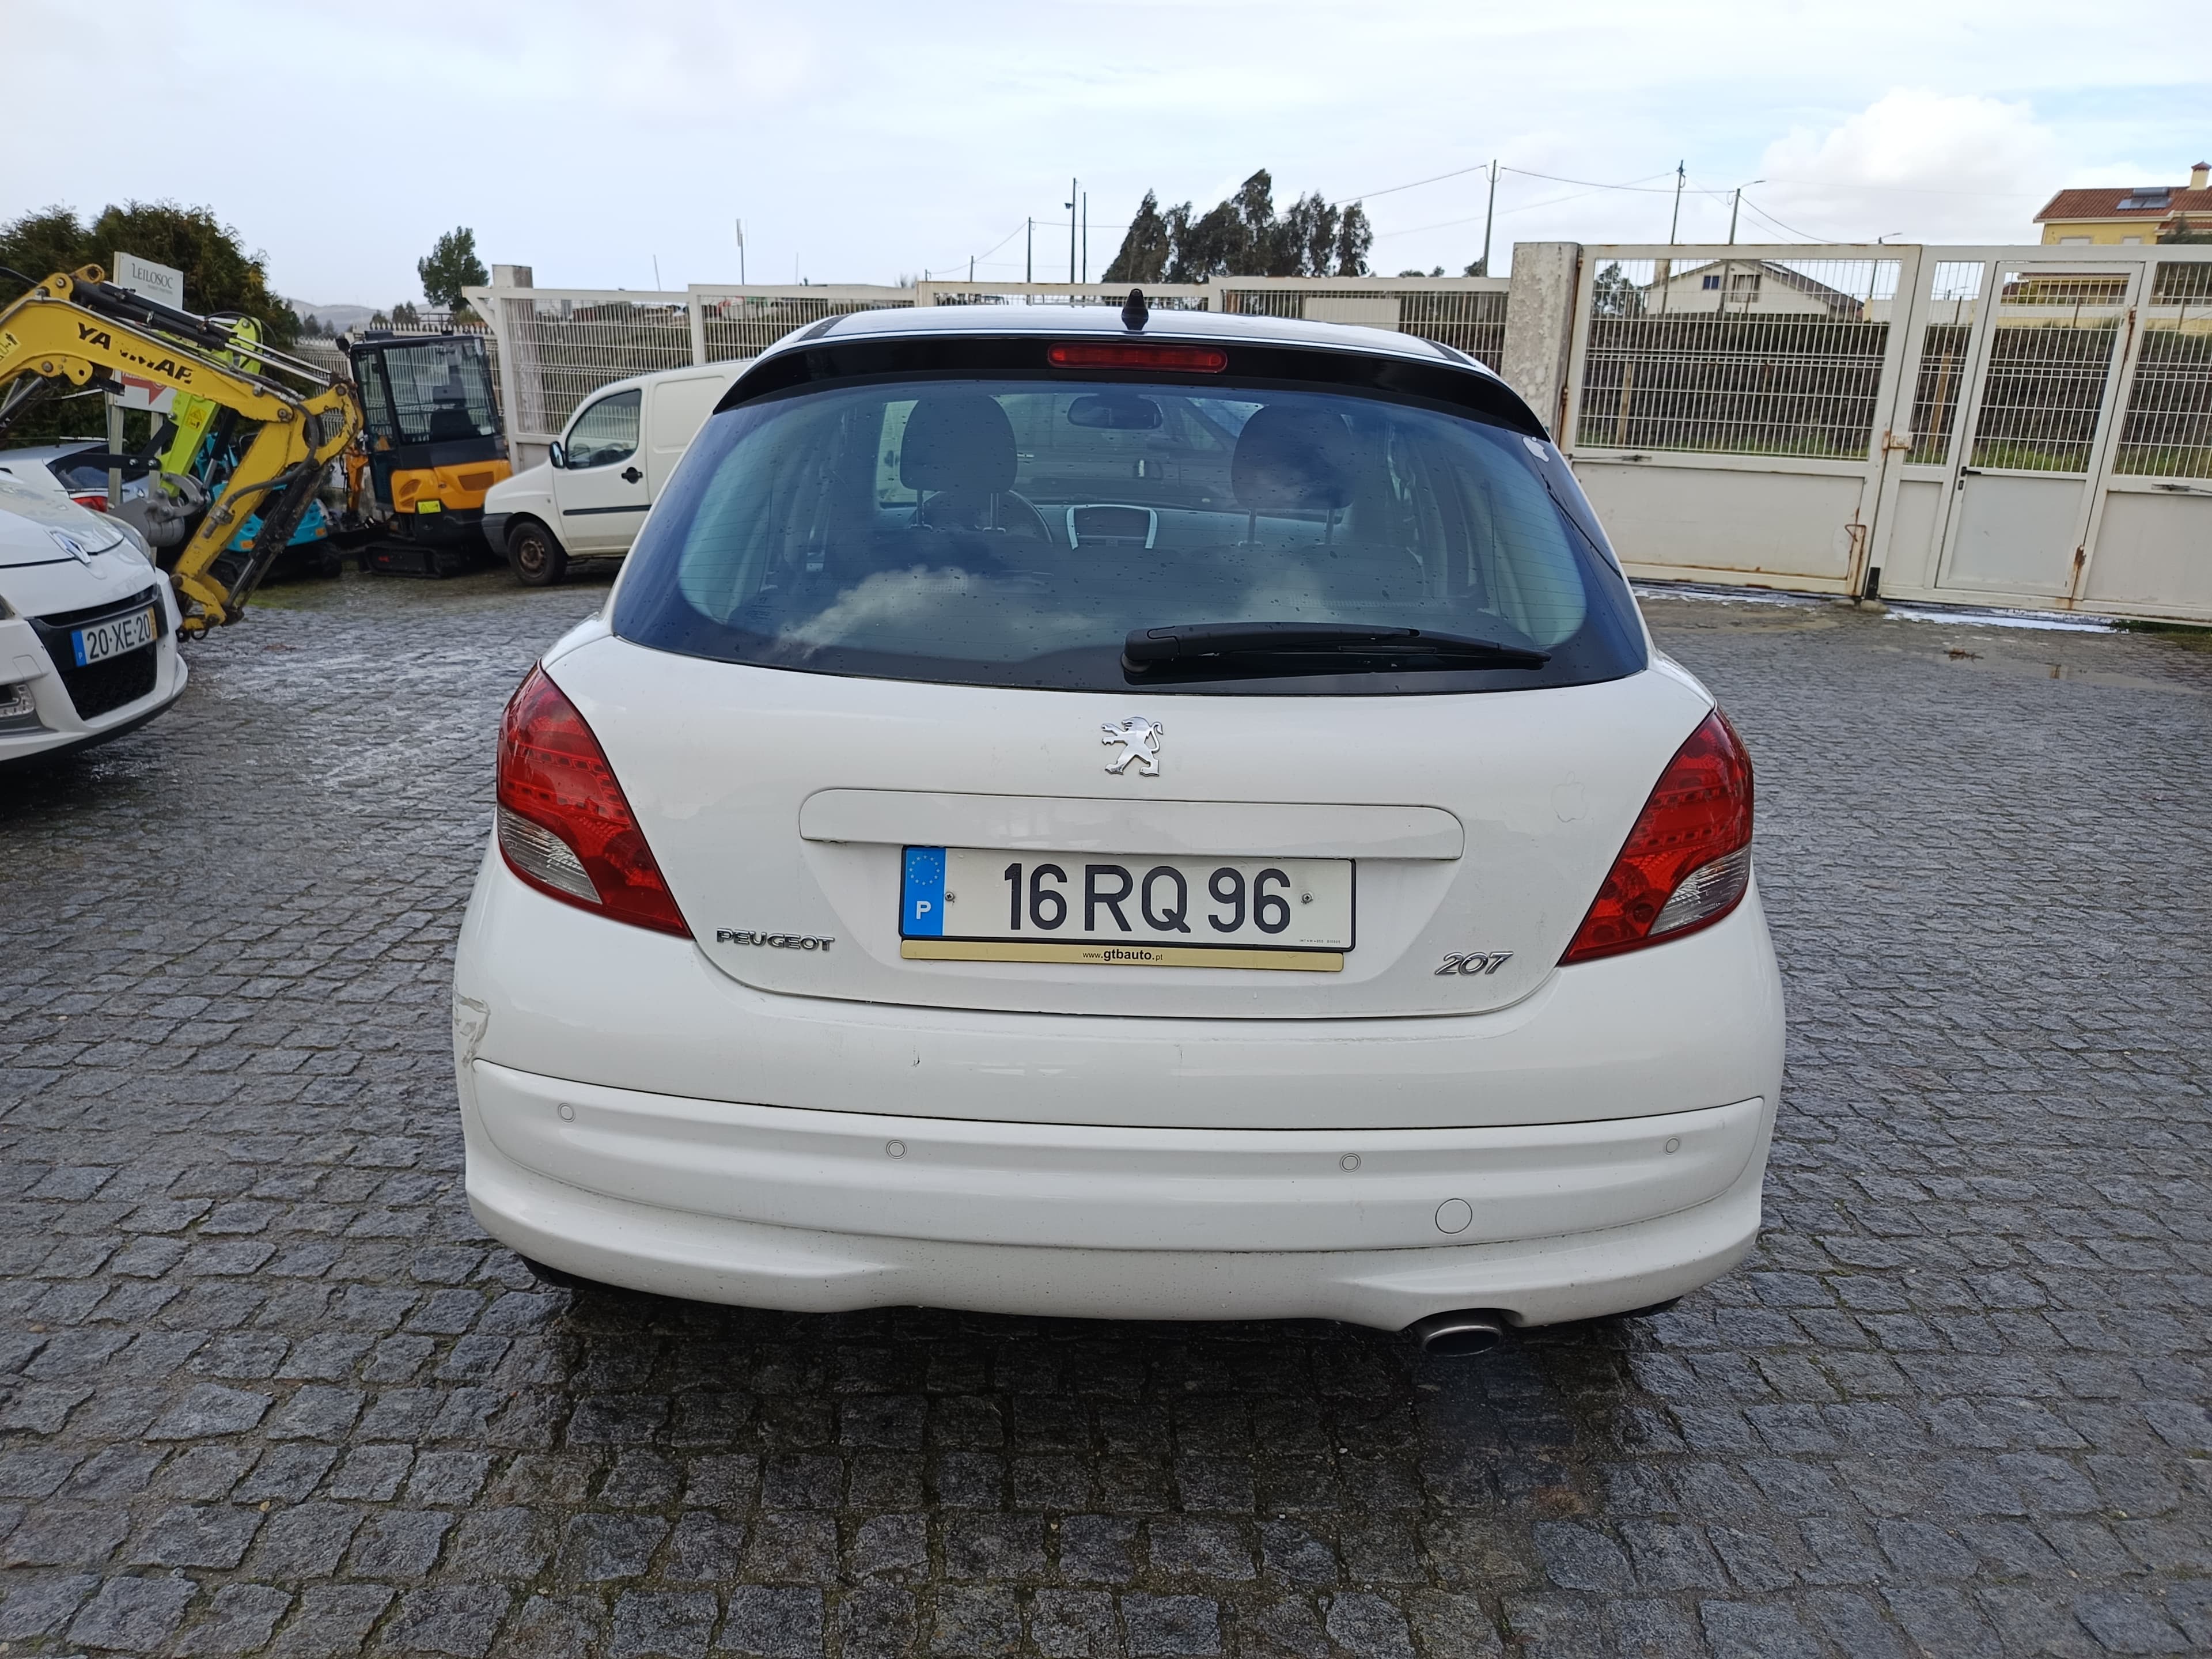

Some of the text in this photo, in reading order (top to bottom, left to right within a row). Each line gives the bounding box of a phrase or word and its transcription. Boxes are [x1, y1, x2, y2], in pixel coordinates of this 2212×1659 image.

[132, 263, 173, 289] LEILOSOC
[78, 321, 194, 384] YAAR
[916, 900, 931, 919] P
[1005, 863, 1291, 934] 16 RQ 96
[717, 927, 835, 952] PEUGEOT
[1082, 949, 1163, 961] www.gtbauto.pt
[1434, 951, 1514, 975] 207
